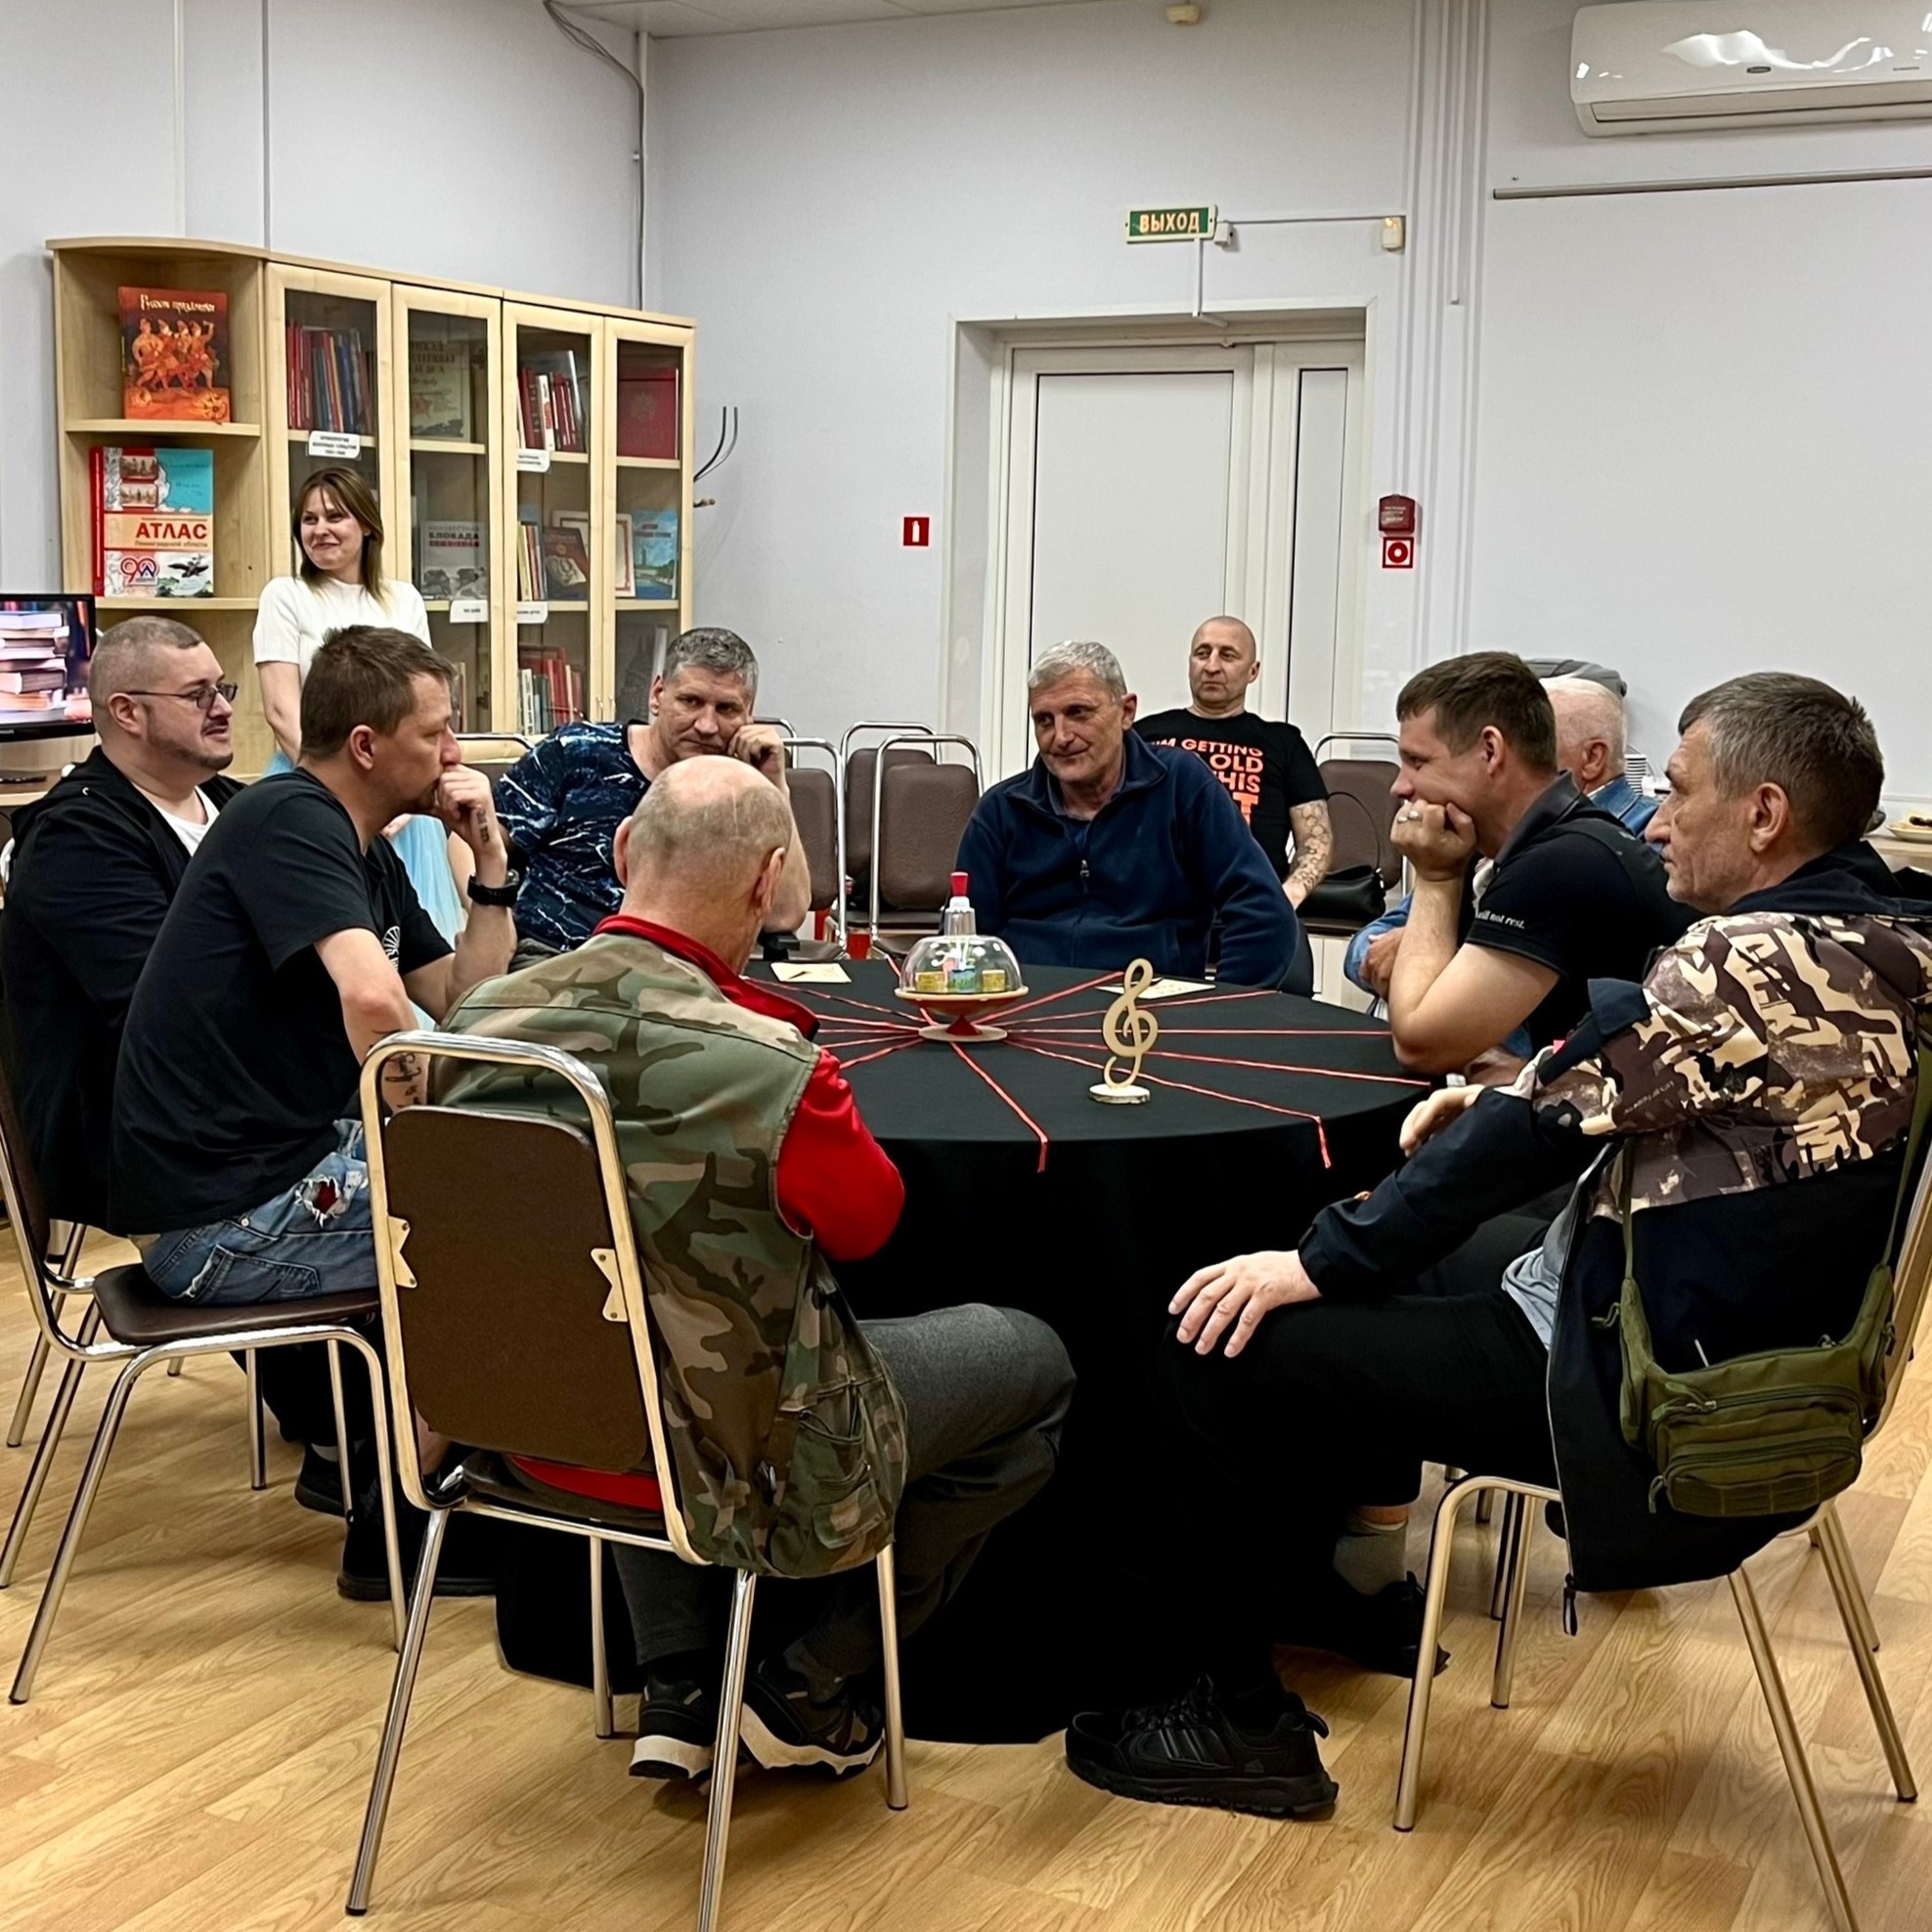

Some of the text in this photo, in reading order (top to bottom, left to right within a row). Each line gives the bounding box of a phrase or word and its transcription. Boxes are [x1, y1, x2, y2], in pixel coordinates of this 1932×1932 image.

[1139, 211, 1200, 234] ВЫХОД
[135, 522, 208, 540] АТЛАС
[1181, 738, 1264, 757] GETTING
[1209, 754, 1264, 773] OLD
[1212, 770, 1261, 794] HIS
